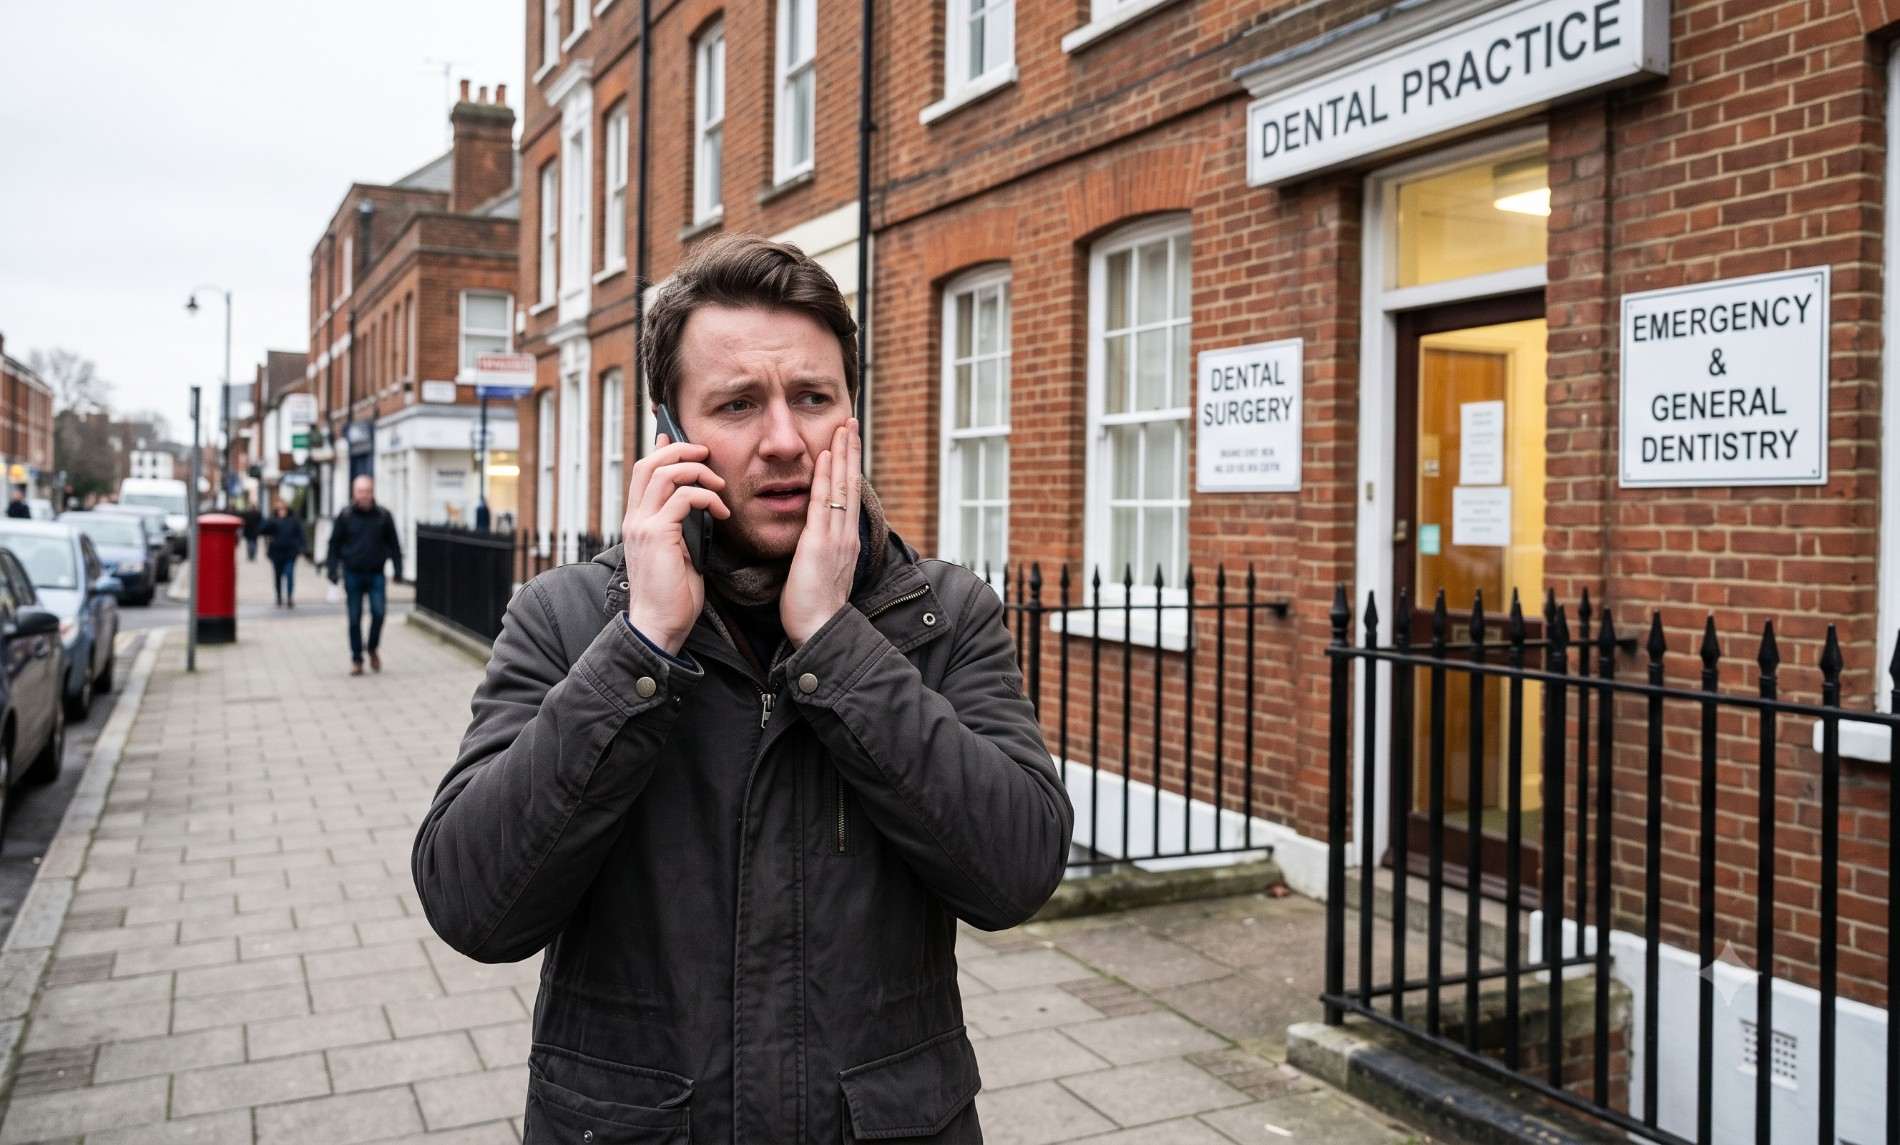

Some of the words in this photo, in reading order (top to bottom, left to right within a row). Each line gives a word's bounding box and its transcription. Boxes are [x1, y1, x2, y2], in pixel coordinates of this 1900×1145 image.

[1262, 84, 1388, 158] DENTAL
[1401, 0, 1621, 114] PRACTICE
[1633, 294, 1812, 342] EMERGENCY
[1211, 361, 1286, 392] DENTAL
[1708, 348, 1726, 376] &
[1203, 396, 1294, 427] SURGERY
[1651, 386, 1787, 421] GENERAL
[1641, 429, 1798, 463] DENTISTRY
